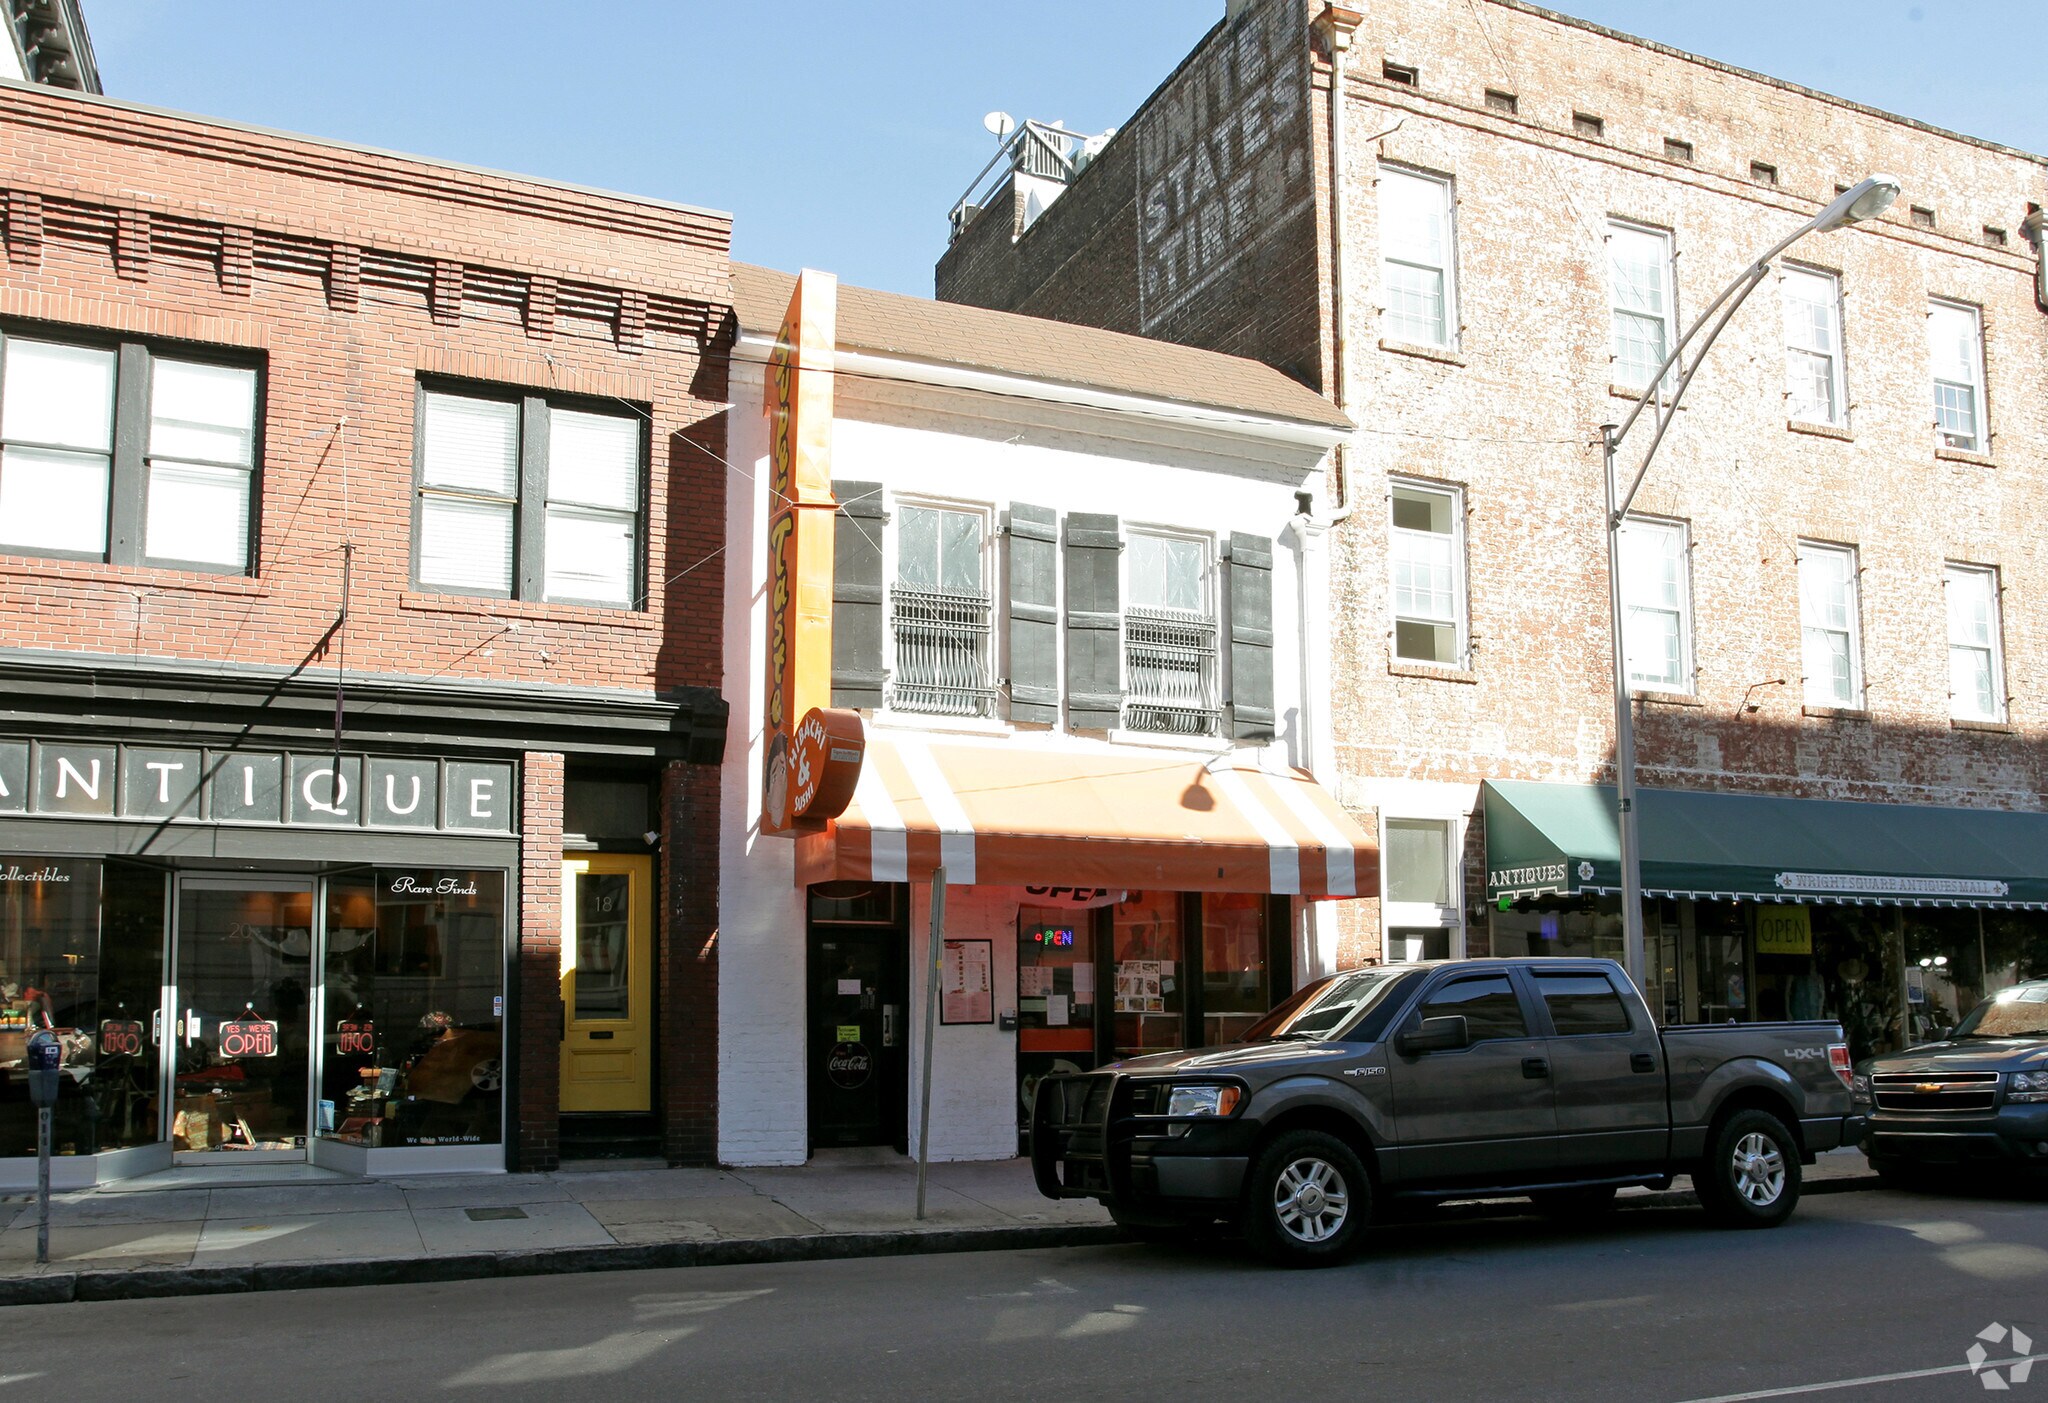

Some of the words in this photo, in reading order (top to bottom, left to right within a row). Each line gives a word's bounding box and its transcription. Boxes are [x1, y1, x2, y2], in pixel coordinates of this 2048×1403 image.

[1145, 54, 1301, 244] STATES
[789, 718, 826, 770] HIBACHI
[797, 747, 810, 787] &
[794, 781, 814, 812] SUSHI
[0, 863, 71, 882] ollectibles
[1488, 864, 1566, 888] ANTIQUES
[390, 876, 433, 894] Rare
[435, 877, 477, 895] Finds
[1796, 874, 1847, 888] WRIGHT
[1849, 877, 1896, 891] SQUARE
[1899, 879, 1958, 893] ANTIQUES
[1959, 881, 1990, 893] MALL
[595, 896, 613, 913] 18
[1034, 929, 1073, 946] OPEN
[1761, 918, 1805, 944] OPEN
[226, 1024, 240, 1034] YES
[225, 1034, 272, 1054] OPEN
